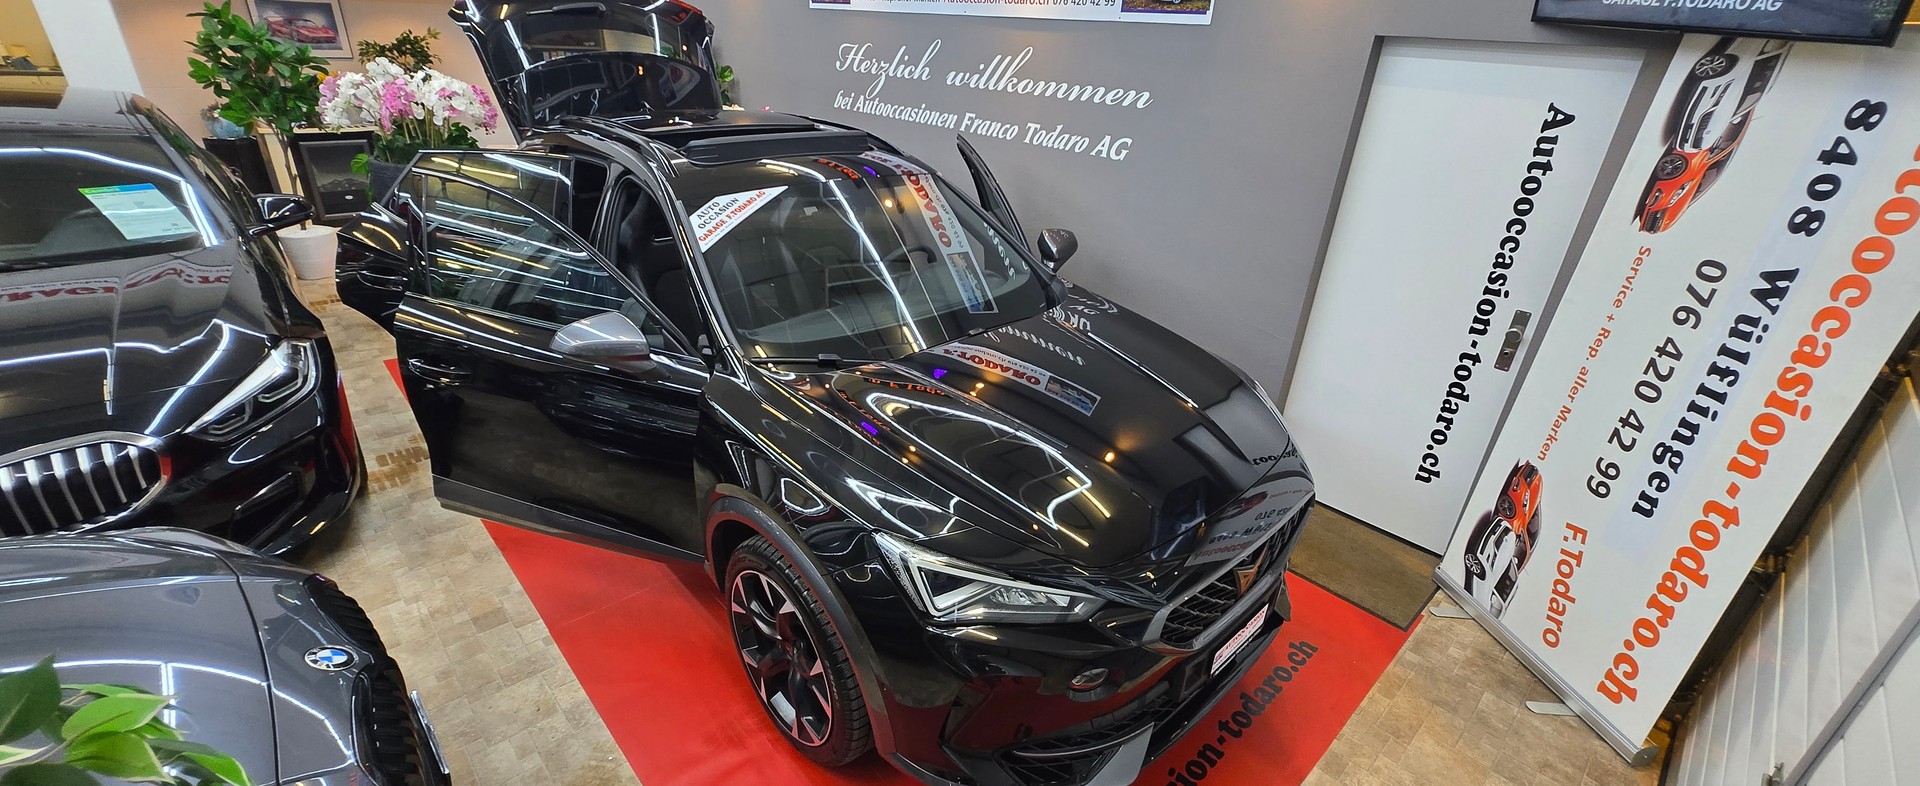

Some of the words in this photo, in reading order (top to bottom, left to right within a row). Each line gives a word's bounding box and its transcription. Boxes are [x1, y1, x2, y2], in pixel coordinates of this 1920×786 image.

[1750, 0, 1783, 12] AG
[835, 39, 942, 100] Herzlich
[945, 46, 1154, 109] willkommen
[833, 90, 852, 111] bei
[853, 93, 958, 131] Autooccasionen
[959, 112, 1019, 142] Franco
[1021, 123, 1090, 154] Todaro
[1090, 135, 1133, 162] AG
[1787, 98, 1888, 238] 8408
[696, 201, 720, 220] AUTO
[697, 197, 739, 230] OCCASION
[698, 218, 727, 242] GARAGE
[725, 197, 757, 220] F.TODARO
[1414, 102, 1576, 485] Autooccasion-todaro.ch
[1612, 245, 1651, 309] Service
[1672, 258, 1727, 330] 076
[1586, 326, 1611, 361] Rep.
[1634, 336, 1684, 404] 420
[1567, 366, 1589, 403] aller
[1632, 267, 1800, 519] Wülflingen
[1537, 405, 1572, 461] Marken
[1597, 142, 1920, 705] ooccasion-todaro.ch
[1607, 408, 1645, 452] 42
[1586, 457, 1621, 500] 99
[1542, 521, 1588, 649] F.Todaro
[1164, 640, 1319, 786] ion-todaro.ch
